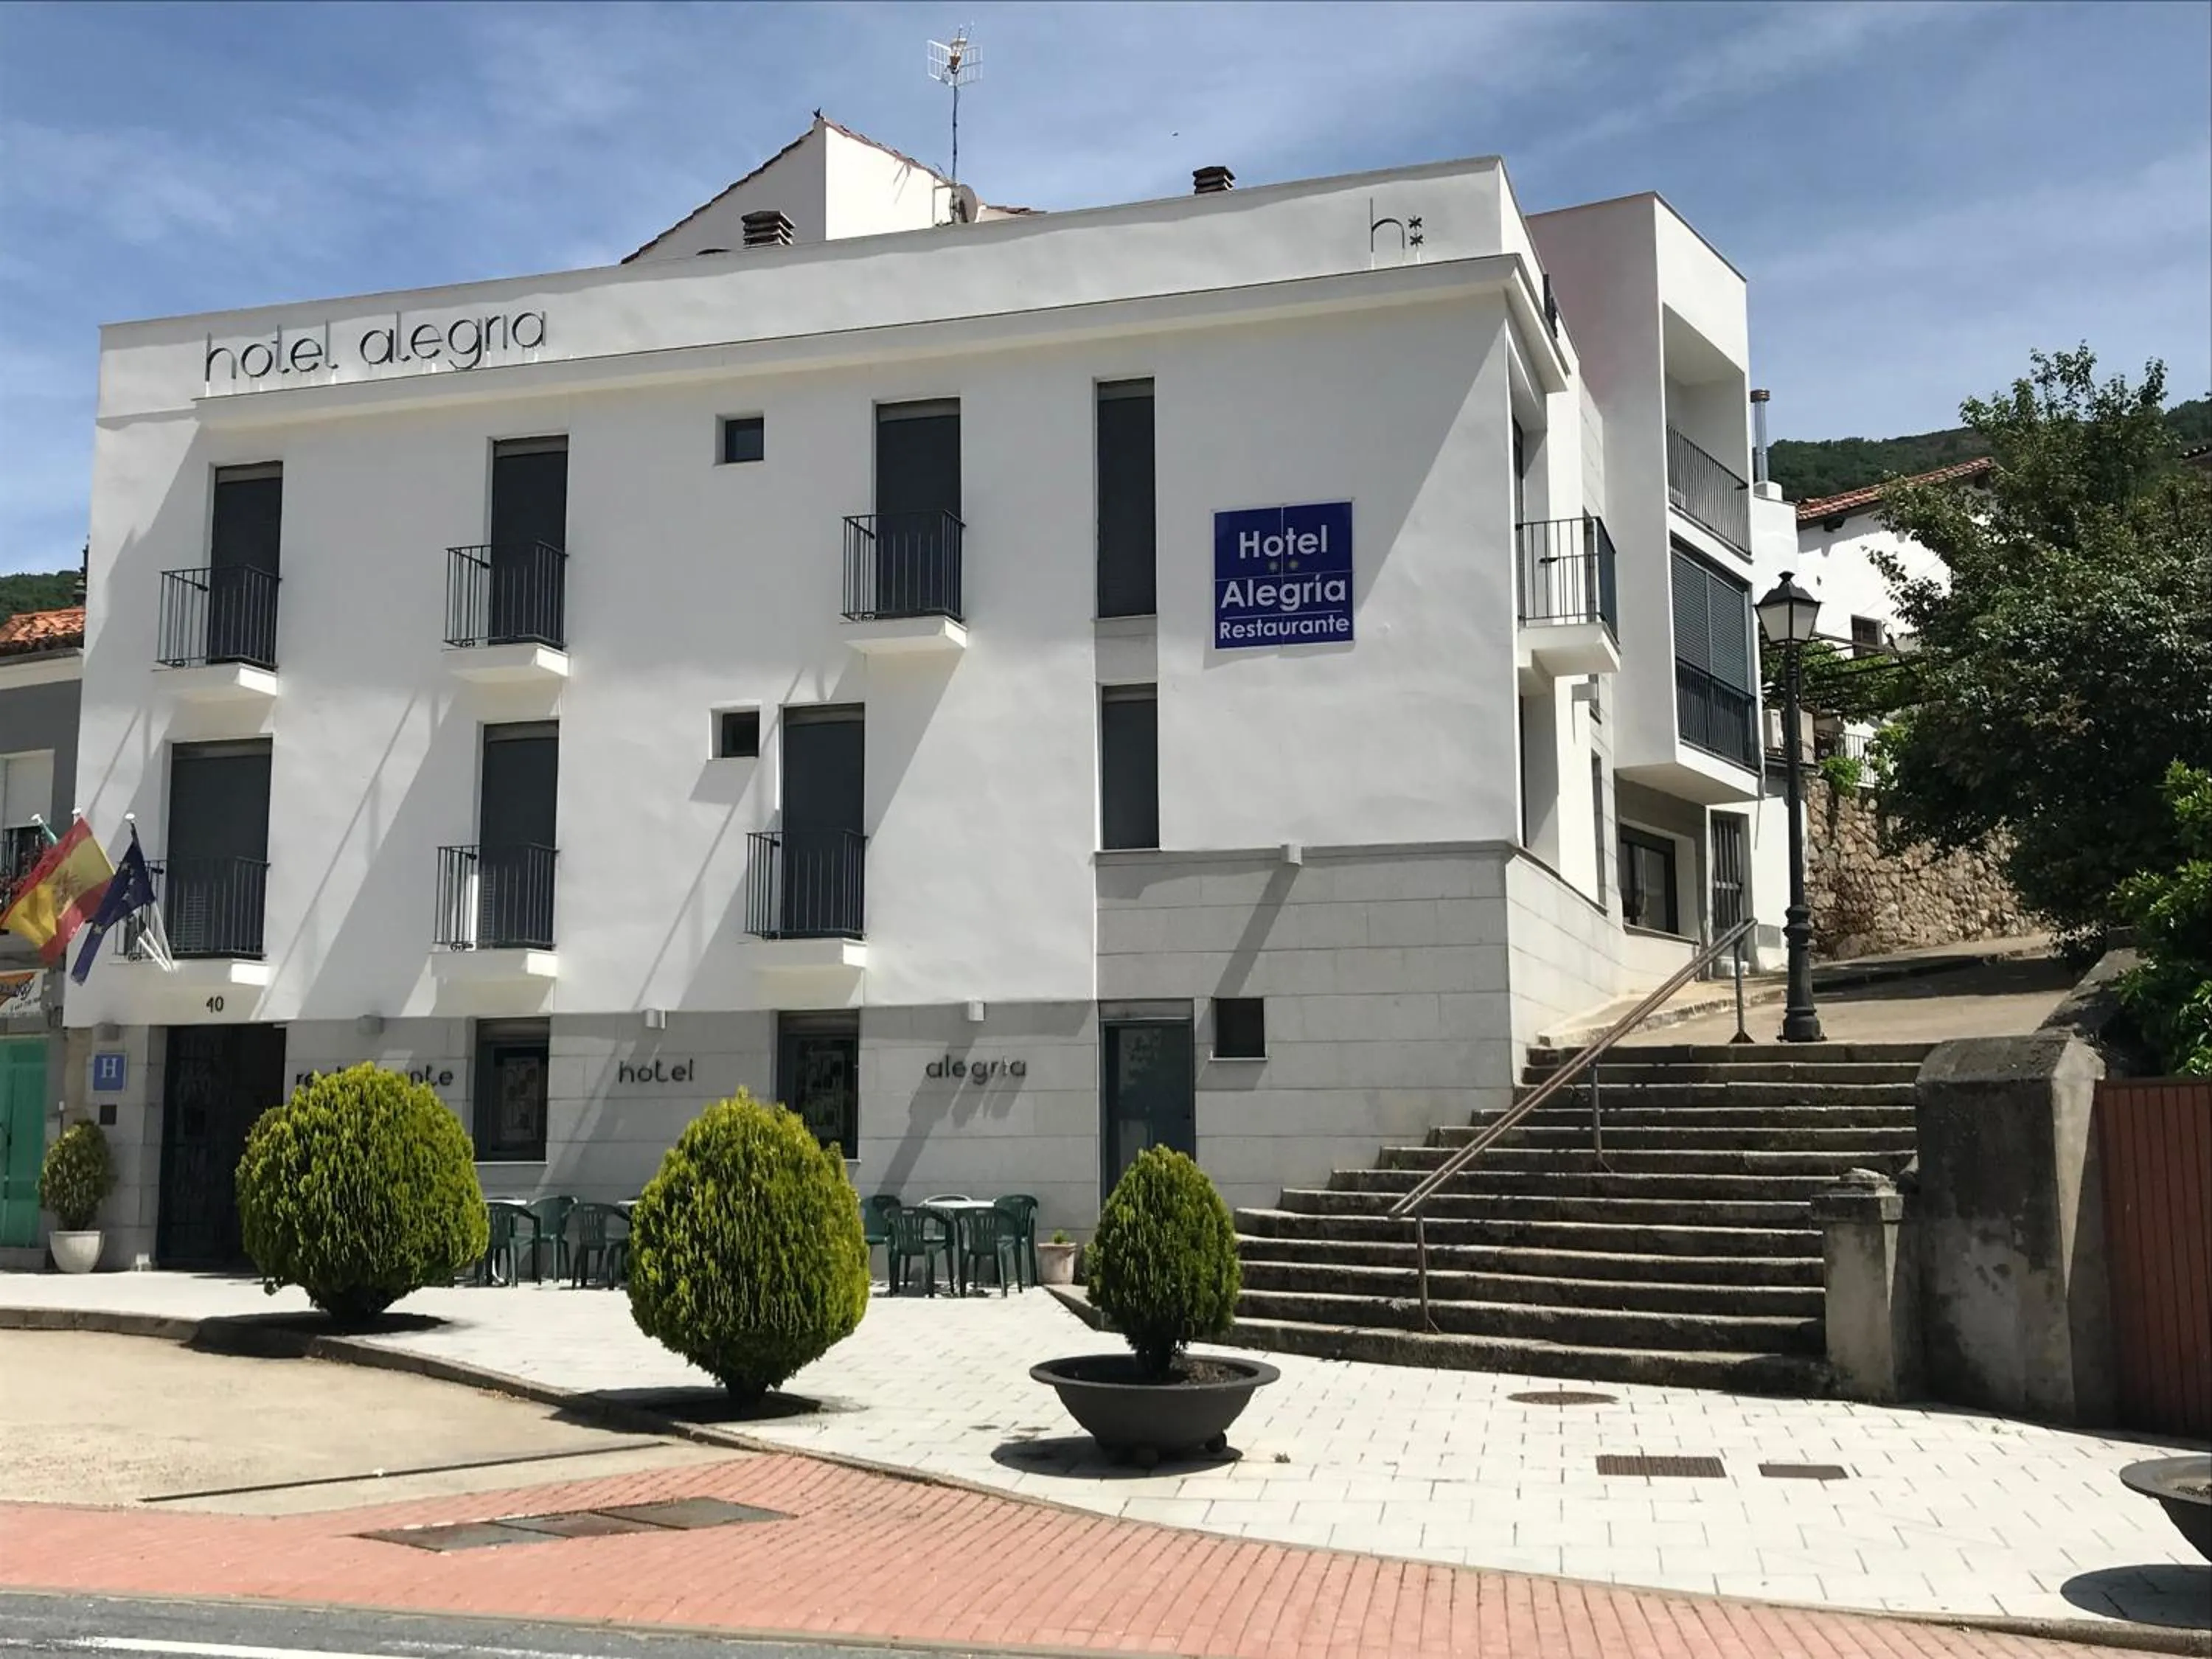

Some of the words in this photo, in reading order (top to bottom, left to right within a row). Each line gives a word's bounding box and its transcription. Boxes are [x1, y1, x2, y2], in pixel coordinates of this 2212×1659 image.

[204, 319, 338, 382] hotel
[1239, 524, 1328, 559] Hotel
[1220, 574, 1346, 611] Alegría
[1219, 615, 1350, 640] Restaurante
[206, 995, 224, 1013] 40
[101, 1057, 117, 1079] H
[619, 1058, 693, 1083] hotel
